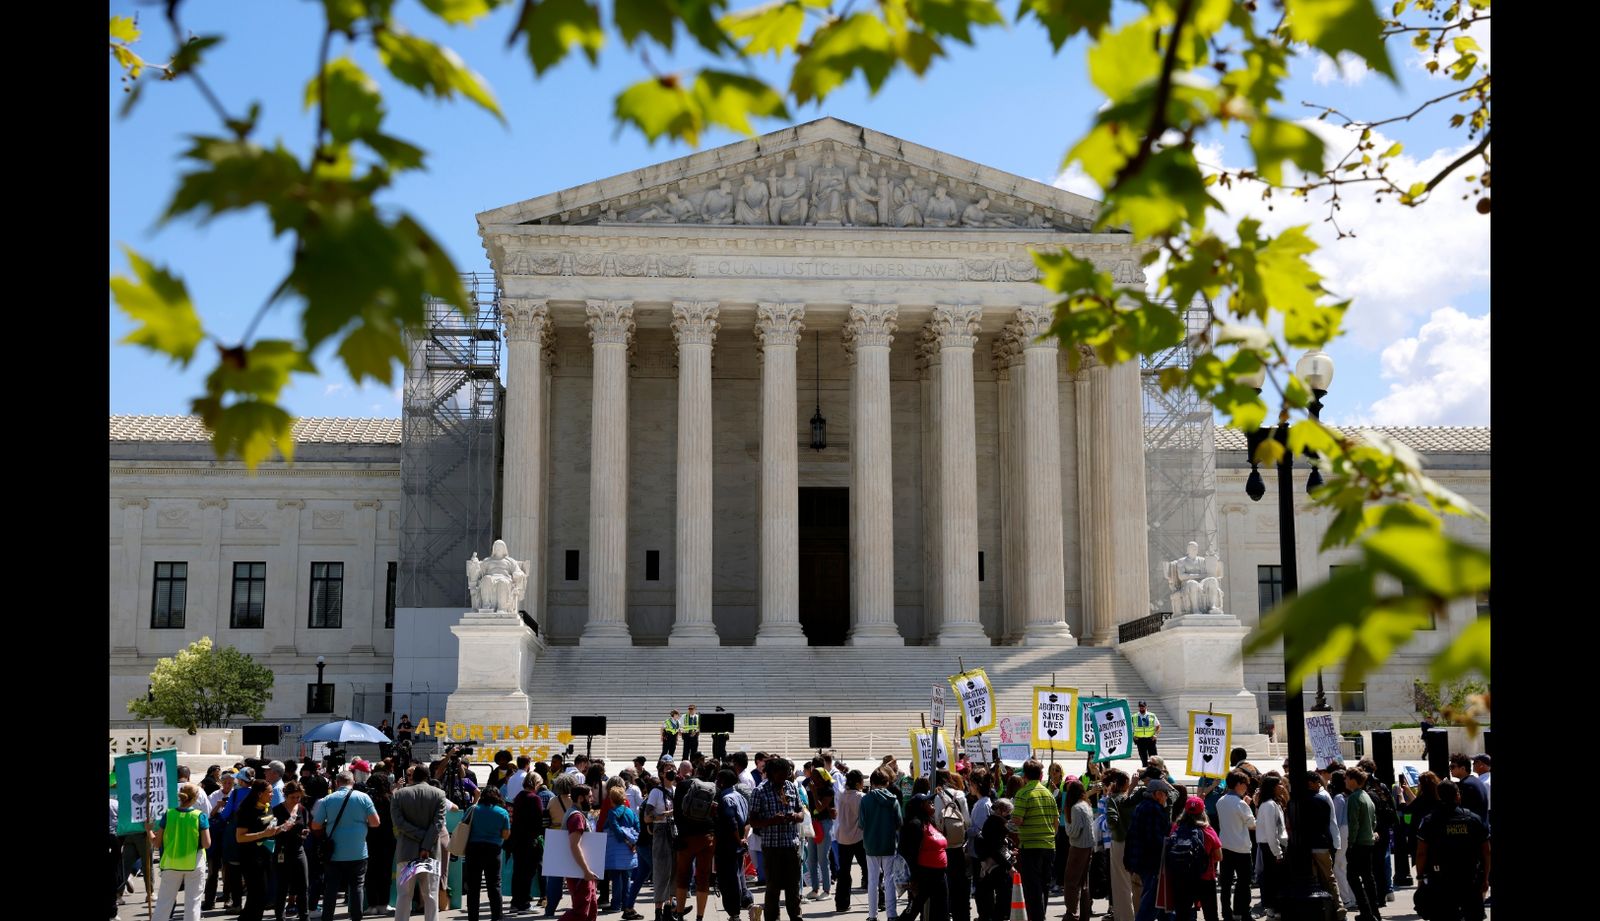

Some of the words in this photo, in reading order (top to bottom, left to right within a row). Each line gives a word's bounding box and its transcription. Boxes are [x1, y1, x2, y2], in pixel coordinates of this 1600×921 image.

[707, 261, 771, 275] EQUAL
[774, 262, 841, 276] JUSTICE
[850, 263, 906, 277] UNDER
[914, 263, 949, 277] LAW
[962, 687, 988, 698] ABORTION
[968, 697, 986, 708] SAVES
[1038, 702, 1070, 712] ABORTION
[970, 706, 986, 717] LIVES
[1042, 712, 1064, 721] SAVES
[414, 717, 549, 740] ABORTION
[1043, 720, 1063, 729] LIVES
[1099, 718, 1126, 732] ABORTION
[1104, 729, 1123, 741] SAVES
[1195, 727, 1226, 737] ABORTION
[920, 738, 932, 748] WE
[1105, 737, 1122, 748] LIVES
[1198, 737, 1221, 746] SAVES
[922, 748, 942, 760] KEP
[1199, 745, 1219, 755] LIVES
[1446, 827, 1469, 835] POLICE
